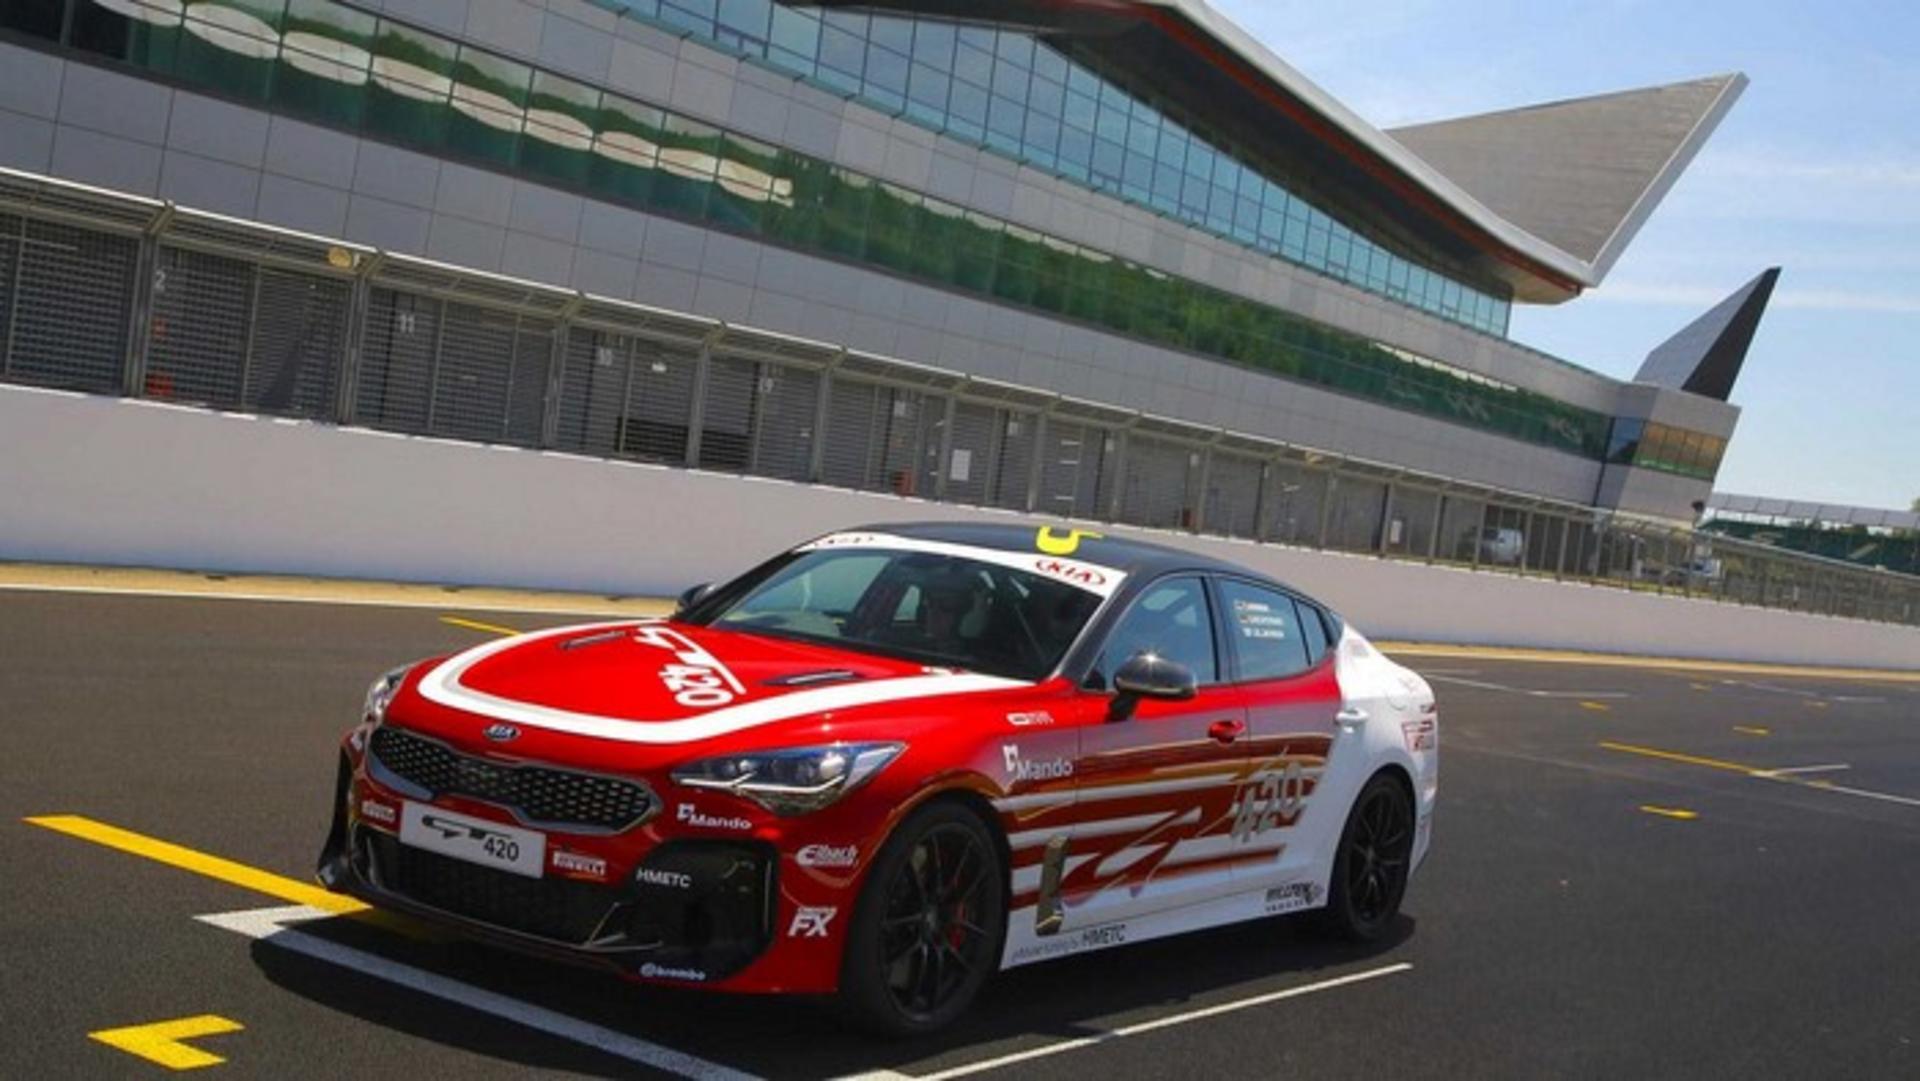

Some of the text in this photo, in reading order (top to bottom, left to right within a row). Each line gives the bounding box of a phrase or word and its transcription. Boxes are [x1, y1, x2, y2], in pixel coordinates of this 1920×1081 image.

[1046, 561, 1093, 583] KIA
[657, 663, 735, 708] 420
[1016, 758, 1074, 780] Mando
[688, 814, 753, 830] Mando
[483, 836, 520, 862] 420
[636, 867, 692, 888] HMETC
[787, 912, 837, 938] FX
